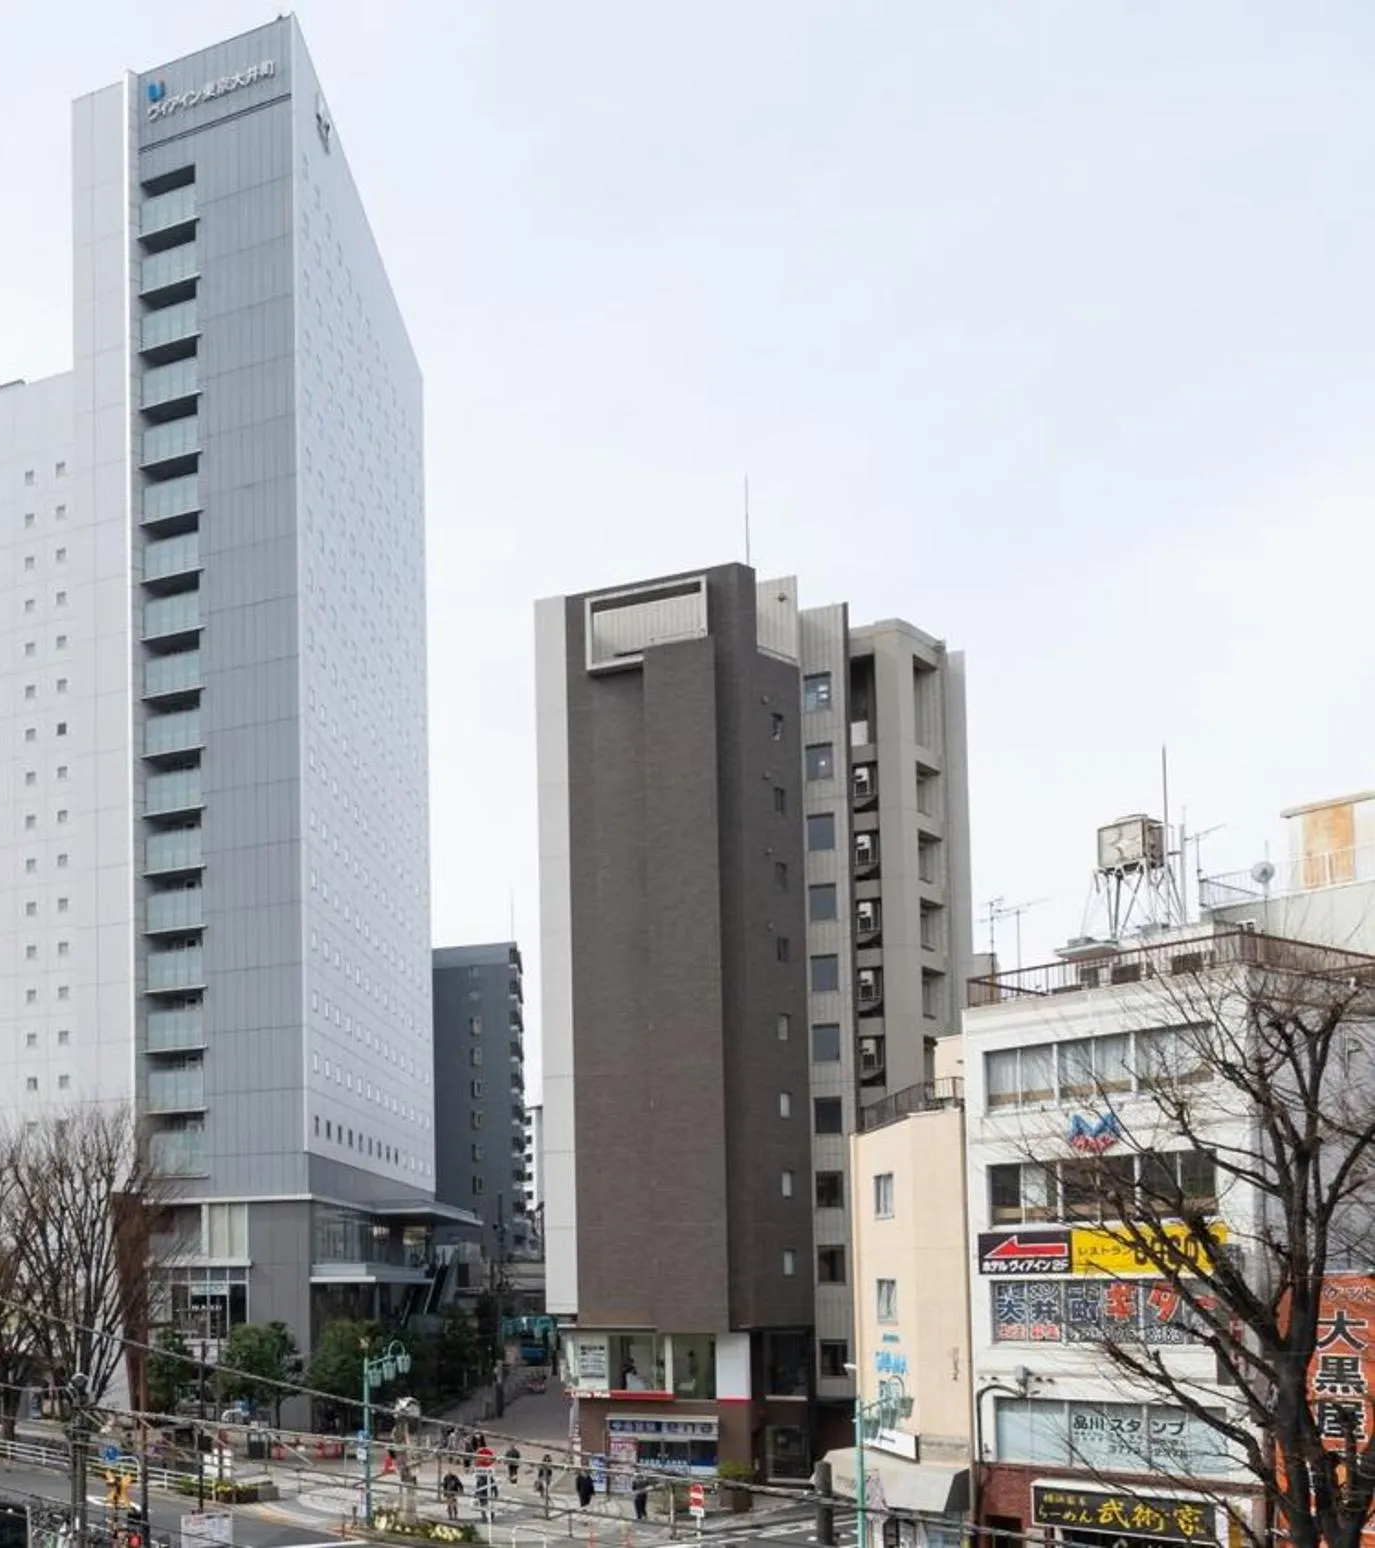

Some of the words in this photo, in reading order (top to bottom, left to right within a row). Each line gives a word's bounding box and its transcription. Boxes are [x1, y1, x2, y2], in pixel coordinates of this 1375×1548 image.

[1074, 1415, 1185, 1435] 品川スタンプ
[1038, 1504, 1093, 1524] らーめん
